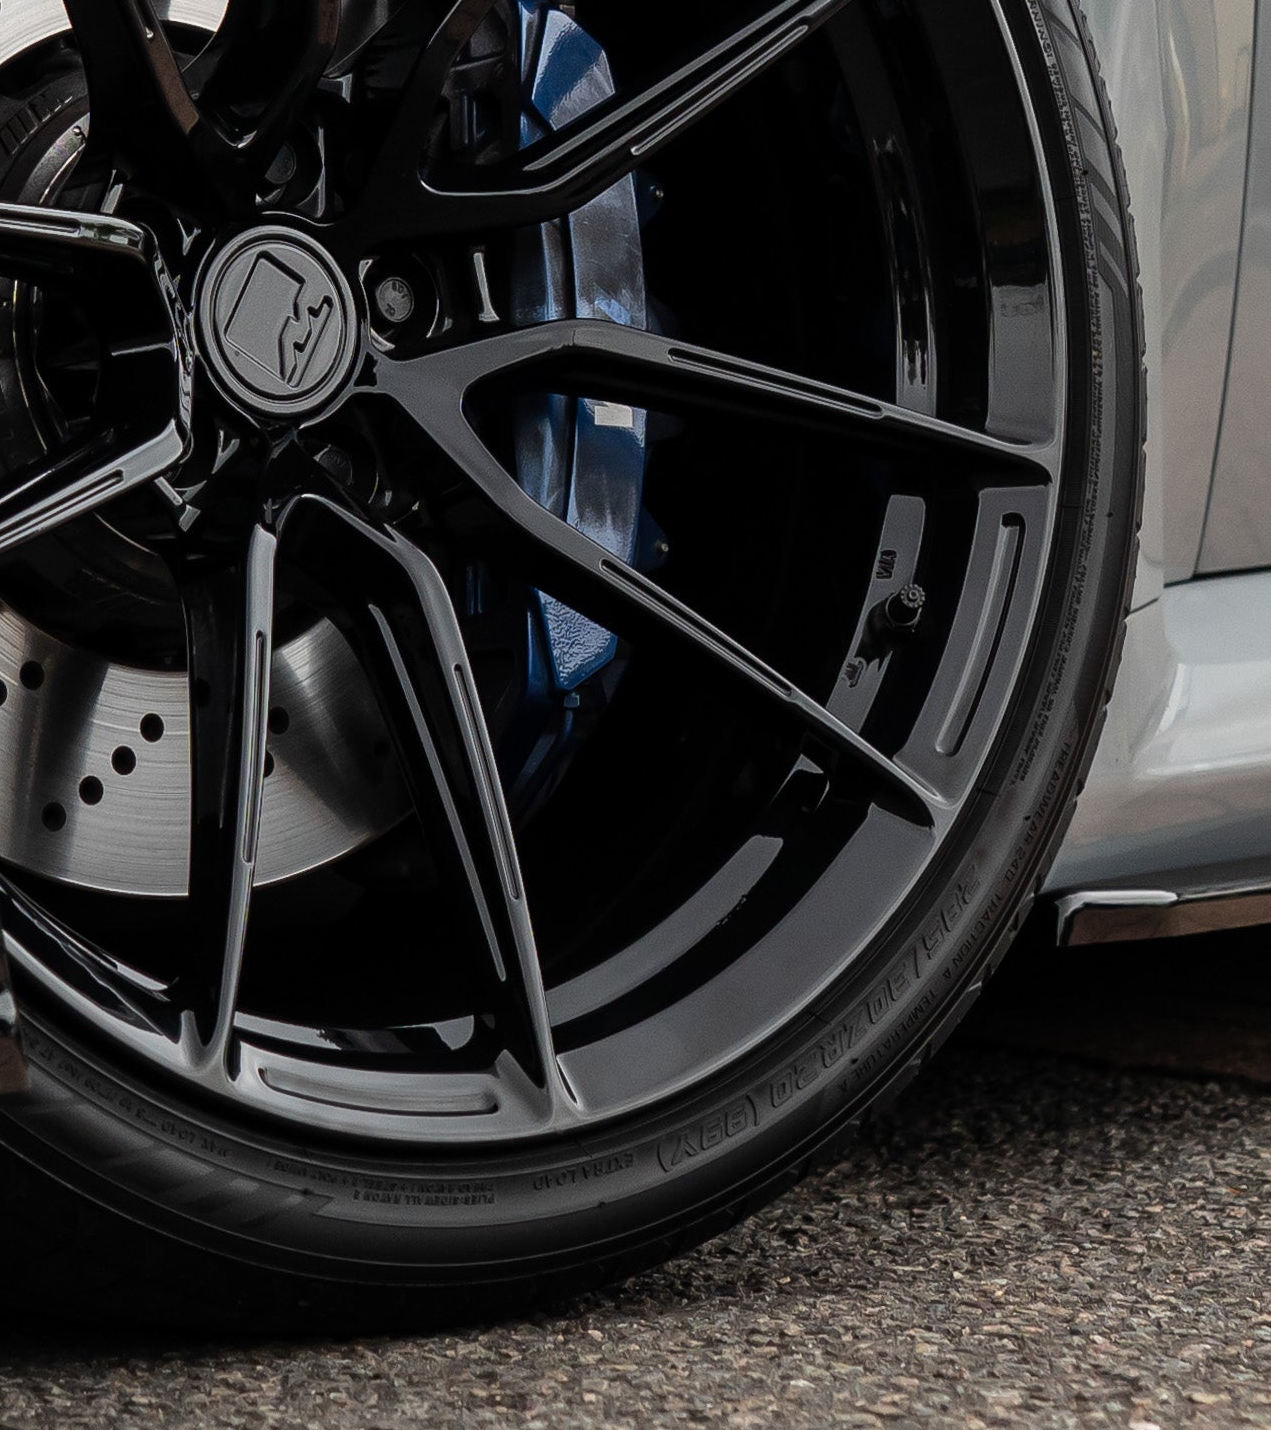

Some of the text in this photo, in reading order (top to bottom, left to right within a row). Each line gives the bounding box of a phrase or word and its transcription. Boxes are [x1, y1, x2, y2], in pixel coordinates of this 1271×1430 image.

[1005, 741, 1072, 882] TREADWEAR 240
[941, 892, 1002, 981] TRACTION A
[851, 989, 936, 1080] TEMPERATURE
